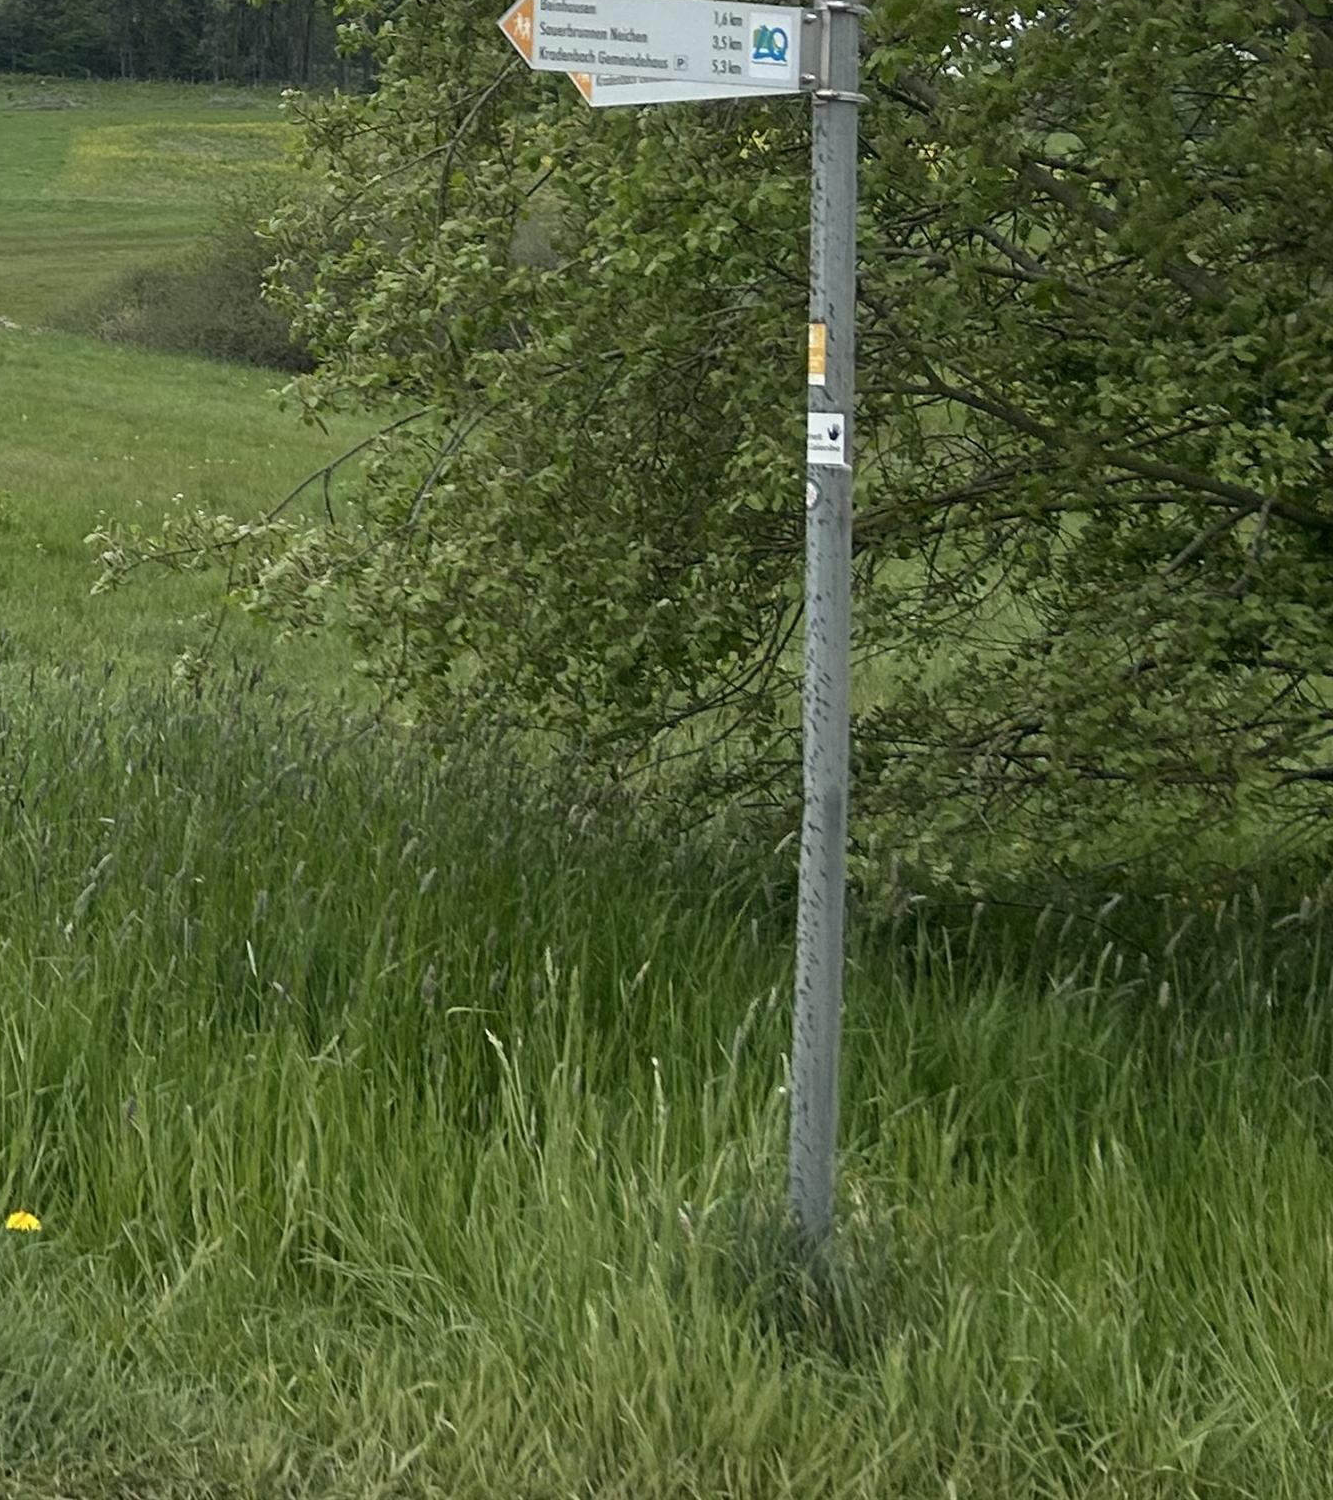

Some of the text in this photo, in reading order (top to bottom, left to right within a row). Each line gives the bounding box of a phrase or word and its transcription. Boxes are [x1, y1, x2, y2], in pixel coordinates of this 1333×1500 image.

[714, 11, 728, 27] 1,6
[729, 12, 743, 26] km
[539, 21, 608, 40] Sauerbrunnen
[712, 35, 728, 51] 3,5
[729, 36, 742, 50] km
[598, 50, 668, 69] Gemeindehaus
[711, 59, 727, 75] 5,3
[728, 60, 742, 74] km
